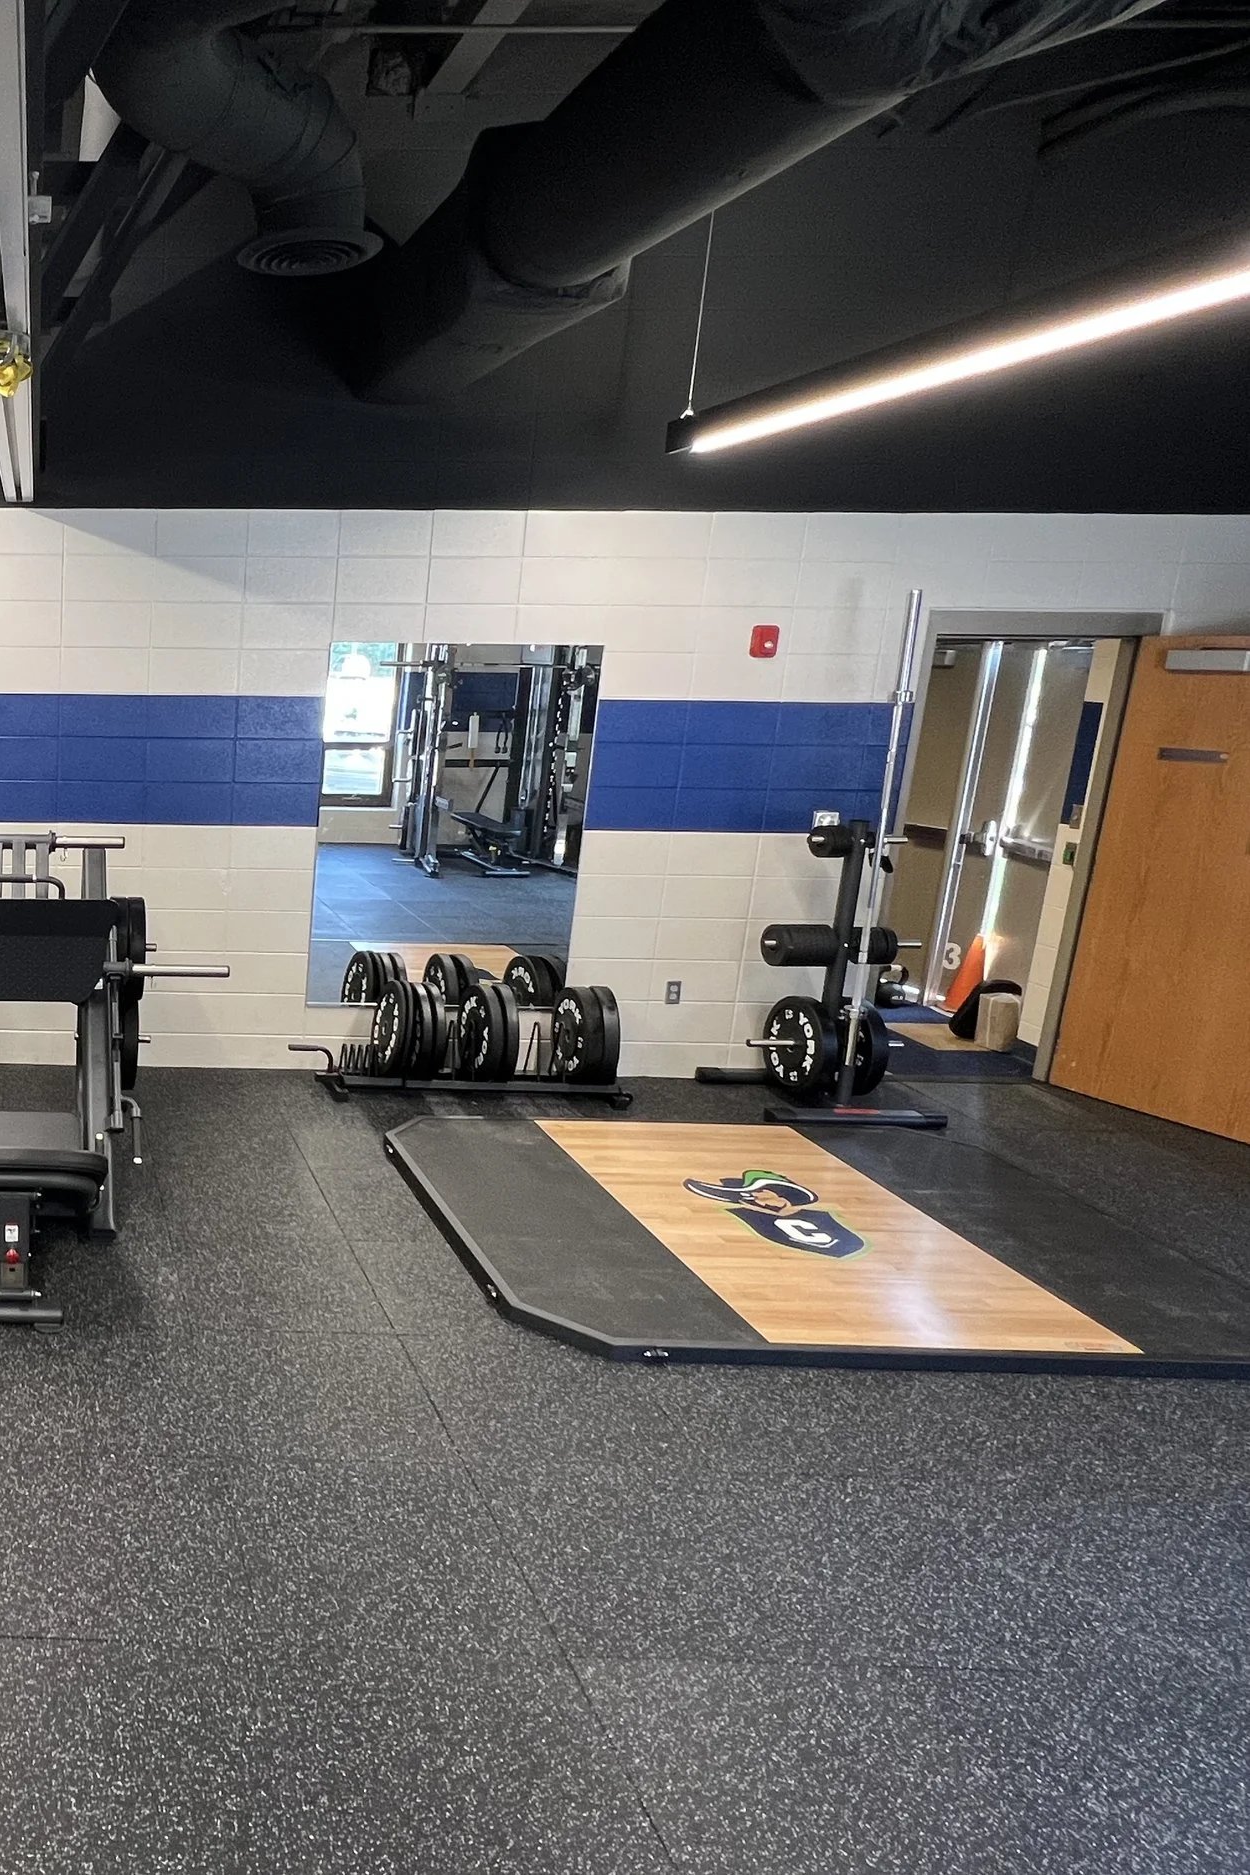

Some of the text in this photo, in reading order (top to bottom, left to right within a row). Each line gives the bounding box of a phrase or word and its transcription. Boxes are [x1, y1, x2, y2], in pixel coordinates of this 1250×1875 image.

[942, 942, 962, 970] 3
[460, 996, 478, 1038] YORK
[558, 998, 582, 1024] YORK
[798, 1012, 815, 1073] YORK
[774, 1218, 835, 1246] C
